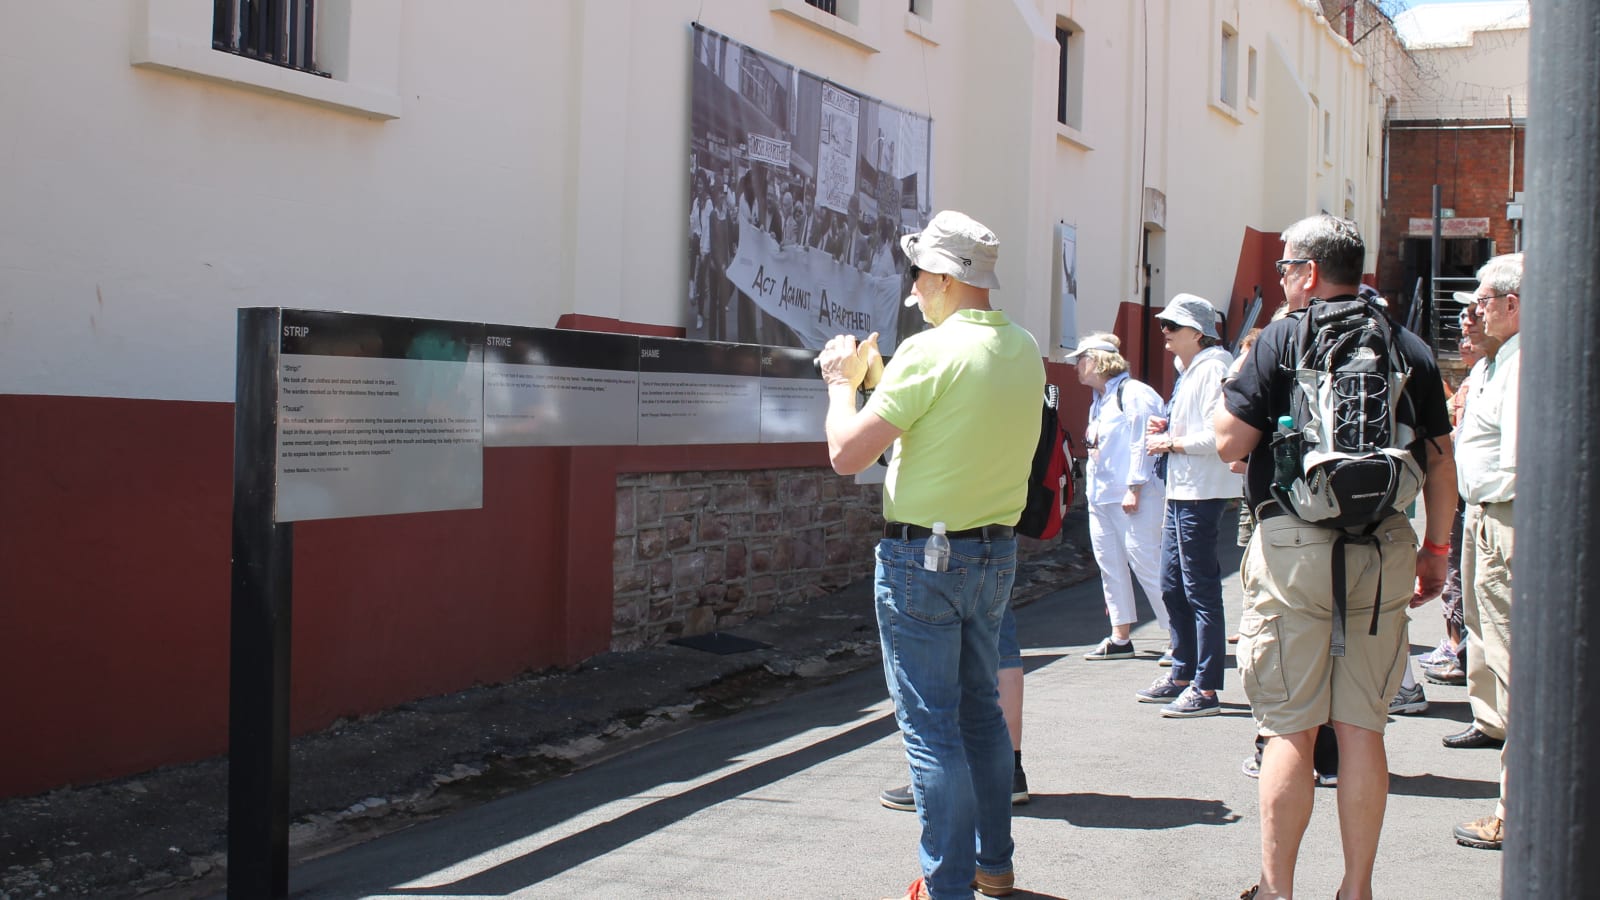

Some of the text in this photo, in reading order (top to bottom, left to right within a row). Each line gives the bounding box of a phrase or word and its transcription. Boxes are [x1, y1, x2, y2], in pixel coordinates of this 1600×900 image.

[752, 265, 871, 333] ACT AGAINST APARTHEID
[283, 325, 309, 337] STRIP
[486, 336, 512, 348] STRIKE
[641, 349, 660, 359] SHAME
